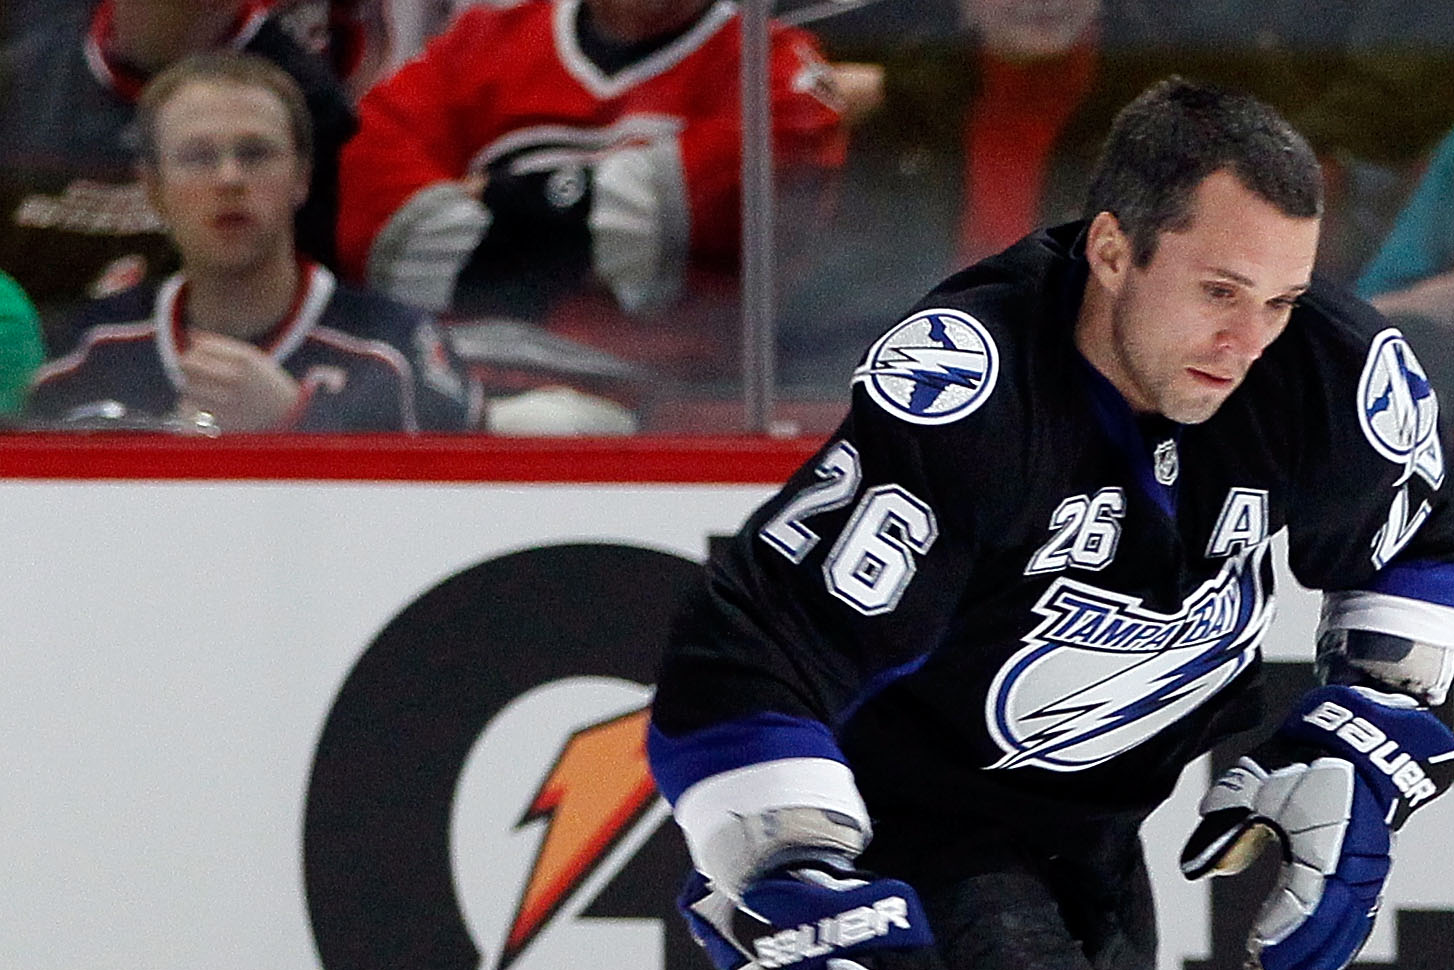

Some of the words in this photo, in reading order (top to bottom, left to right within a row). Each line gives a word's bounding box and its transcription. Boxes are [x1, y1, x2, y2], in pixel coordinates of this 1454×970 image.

[757, 438, 940, 616] 26
[1024, 486, 1127, 576] 26
[1205, 487, 1269, 559] A
[1049, 595, 1178, 650] TAMPA
[1180, 577, 1240, 645] BAY
[1302, 701, 1437, 808] BAUER
